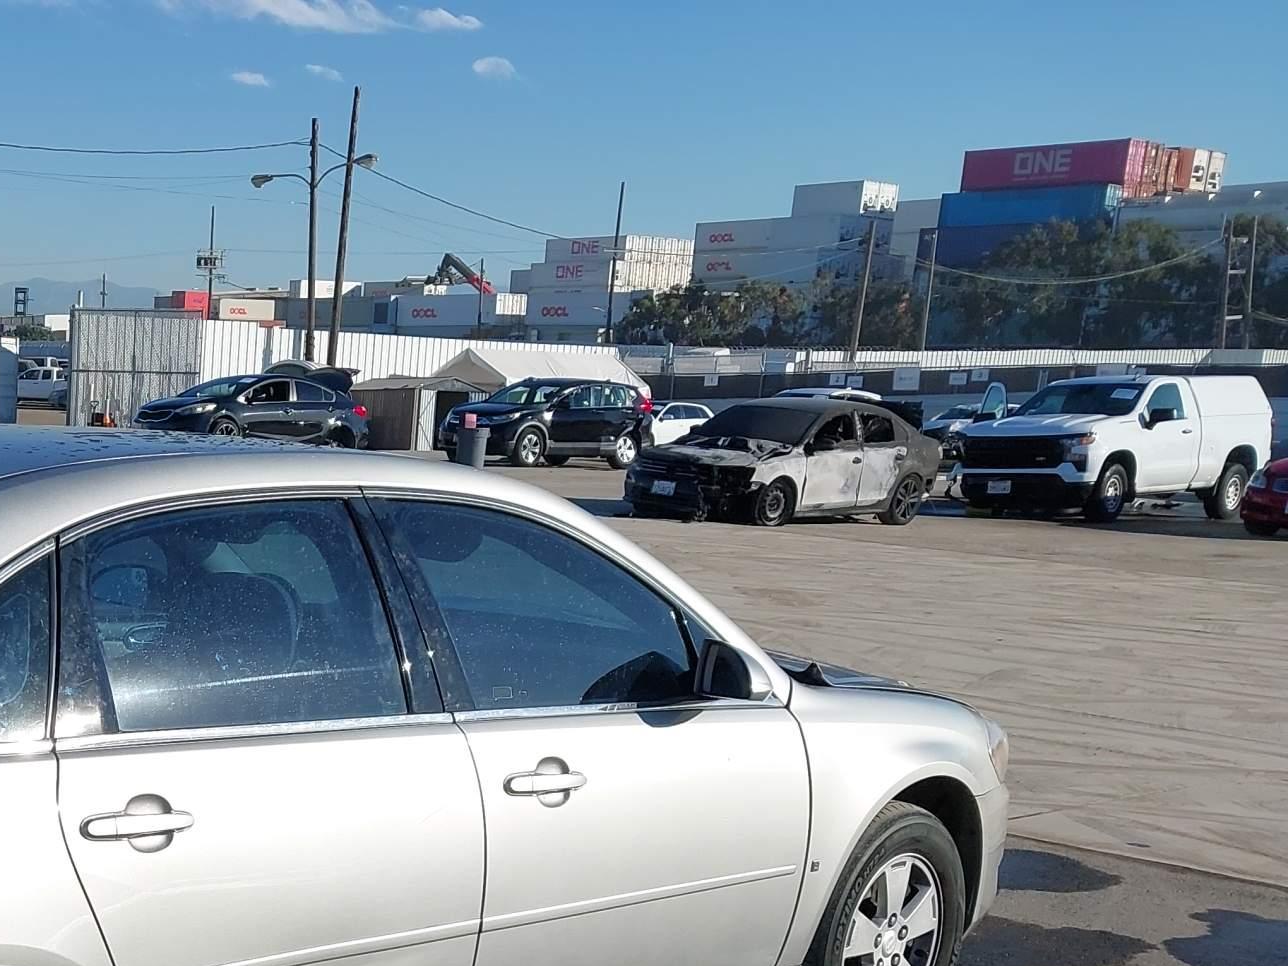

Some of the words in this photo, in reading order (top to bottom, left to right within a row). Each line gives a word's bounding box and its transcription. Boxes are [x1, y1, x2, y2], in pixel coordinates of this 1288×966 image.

[1014, 149, 1072, 174] ONE
[572, 241, 599, 254] ONE
[556, 265, 584, 278] ONE
[229, 307, 247, 315] OOCL
[412, 308, 437, 319] OOCL
[541, 306, 569, 317] OOCL
